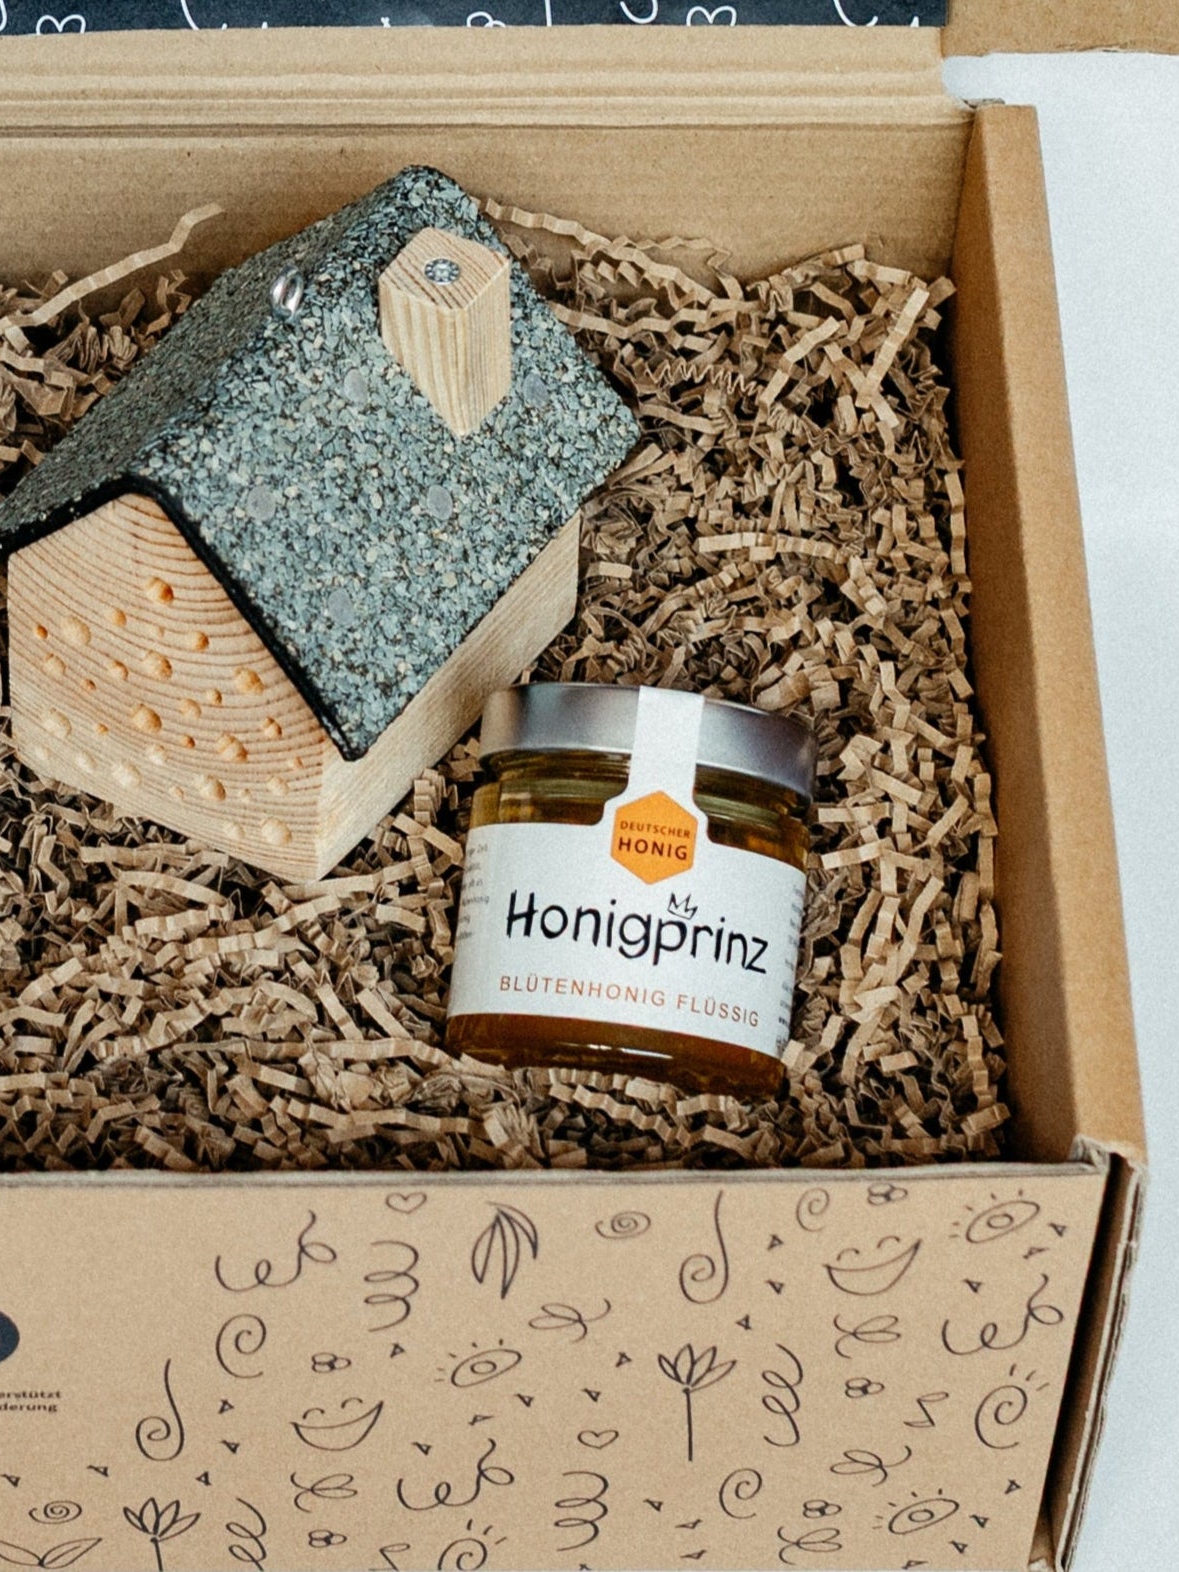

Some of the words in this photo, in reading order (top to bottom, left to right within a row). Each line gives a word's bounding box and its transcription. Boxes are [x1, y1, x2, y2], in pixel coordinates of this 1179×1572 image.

[617, 836, 688, 861] HONIG
[620, 820, 691, 839] DEUTSCHER
[505, 889, 769, 974] Honigprinz
[499, 972, 666, 1007] BLÜTENHONIG
[677, 992, 759, 1028] FLÜSSIG
